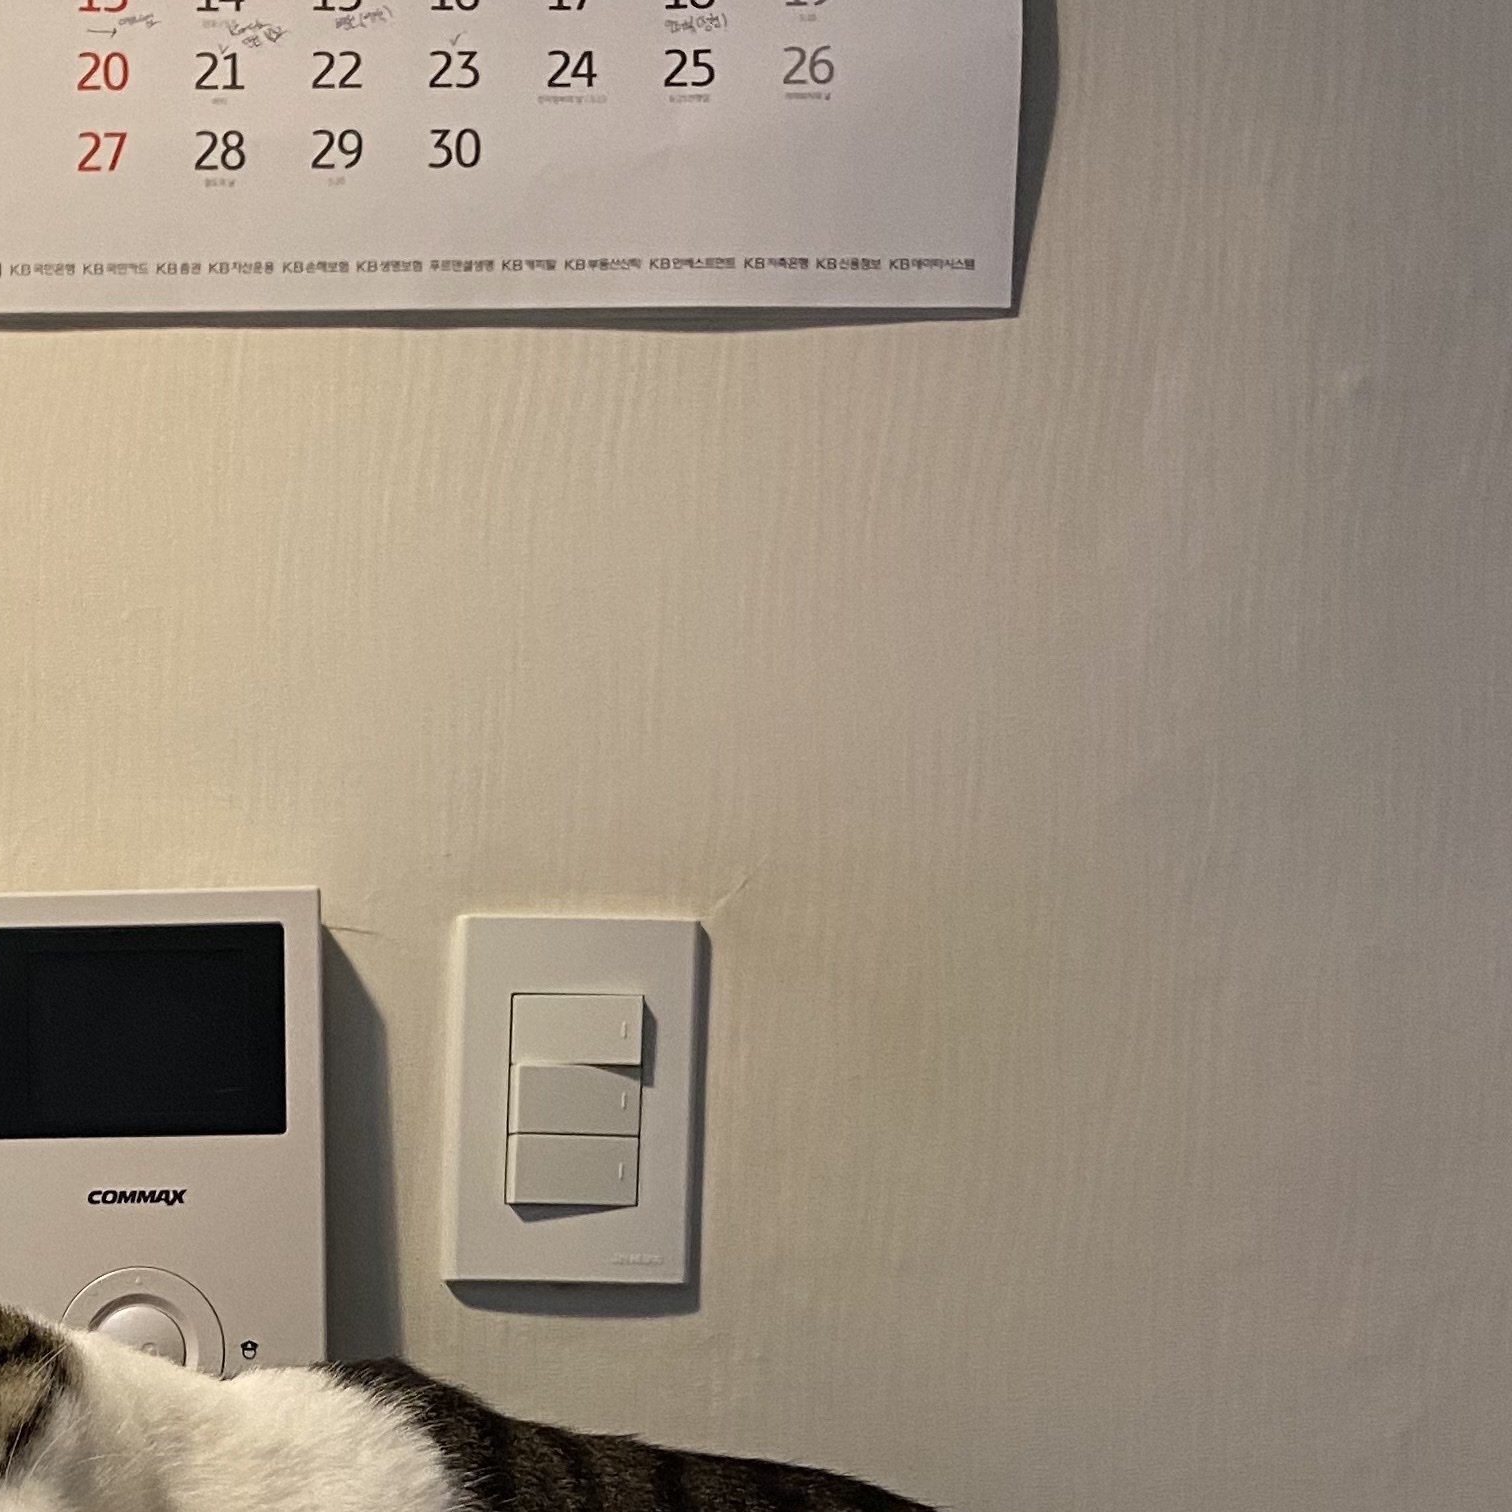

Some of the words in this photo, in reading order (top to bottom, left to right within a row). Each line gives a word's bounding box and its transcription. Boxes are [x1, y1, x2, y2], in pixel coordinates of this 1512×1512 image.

[77, 52, 129, 91] 20
[195, 52, 245, 90] 21
[312, 51, 363, 89] 22
[429, 51, 479, 88] 23
[547, 50, 598, 88] 24
[664, 49, 715, 87] 25
[783, 46, 835, 85] 26
[77, 132, 128, 171] 27
[194, 130, 246, 171] 28
[311, 129, 363, 169] 29
[428, 128, 482, 168] 30
[87, 1188, 188, 1207] COMMAX
